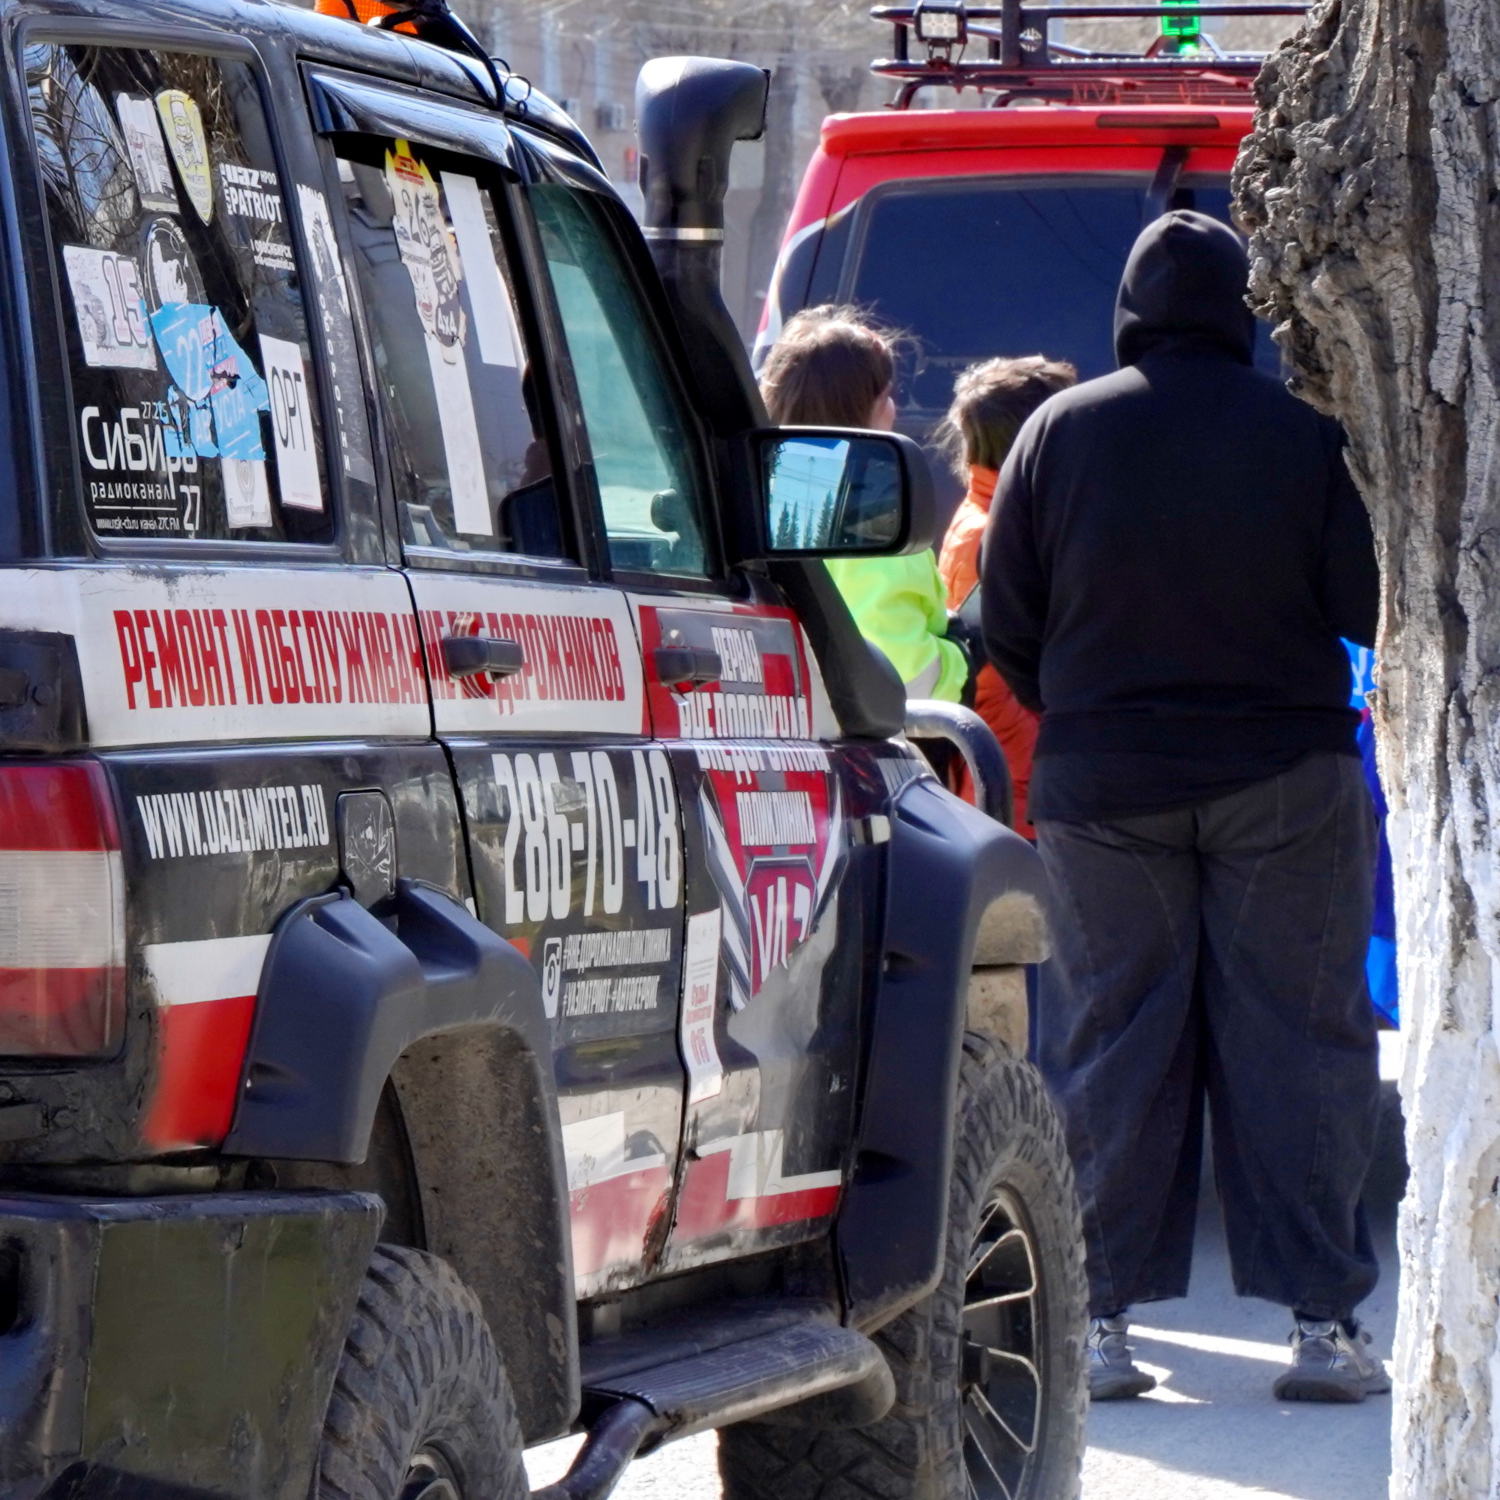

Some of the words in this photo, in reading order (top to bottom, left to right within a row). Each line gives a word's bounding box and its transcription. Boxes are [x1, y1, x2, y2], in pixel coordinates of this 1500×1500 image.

[230, 187, 283, 223] PATRIOT
[101, 255, 148, 348] 15
[271, 365, 307, 452] ОРГ
[90, 481, 172, 503] радиоканал
[180, 484, 200, 532] 27
[113, 609, 238, 710] РЕМОНТ
[230, 609, 264, 706] И
[710, 626, 763, 684] ПЕРВАЯ
[136, 784, 331, 860] WWW.UAZLIMITED.RU
[491, 749, 679, 925] 286-70-48
